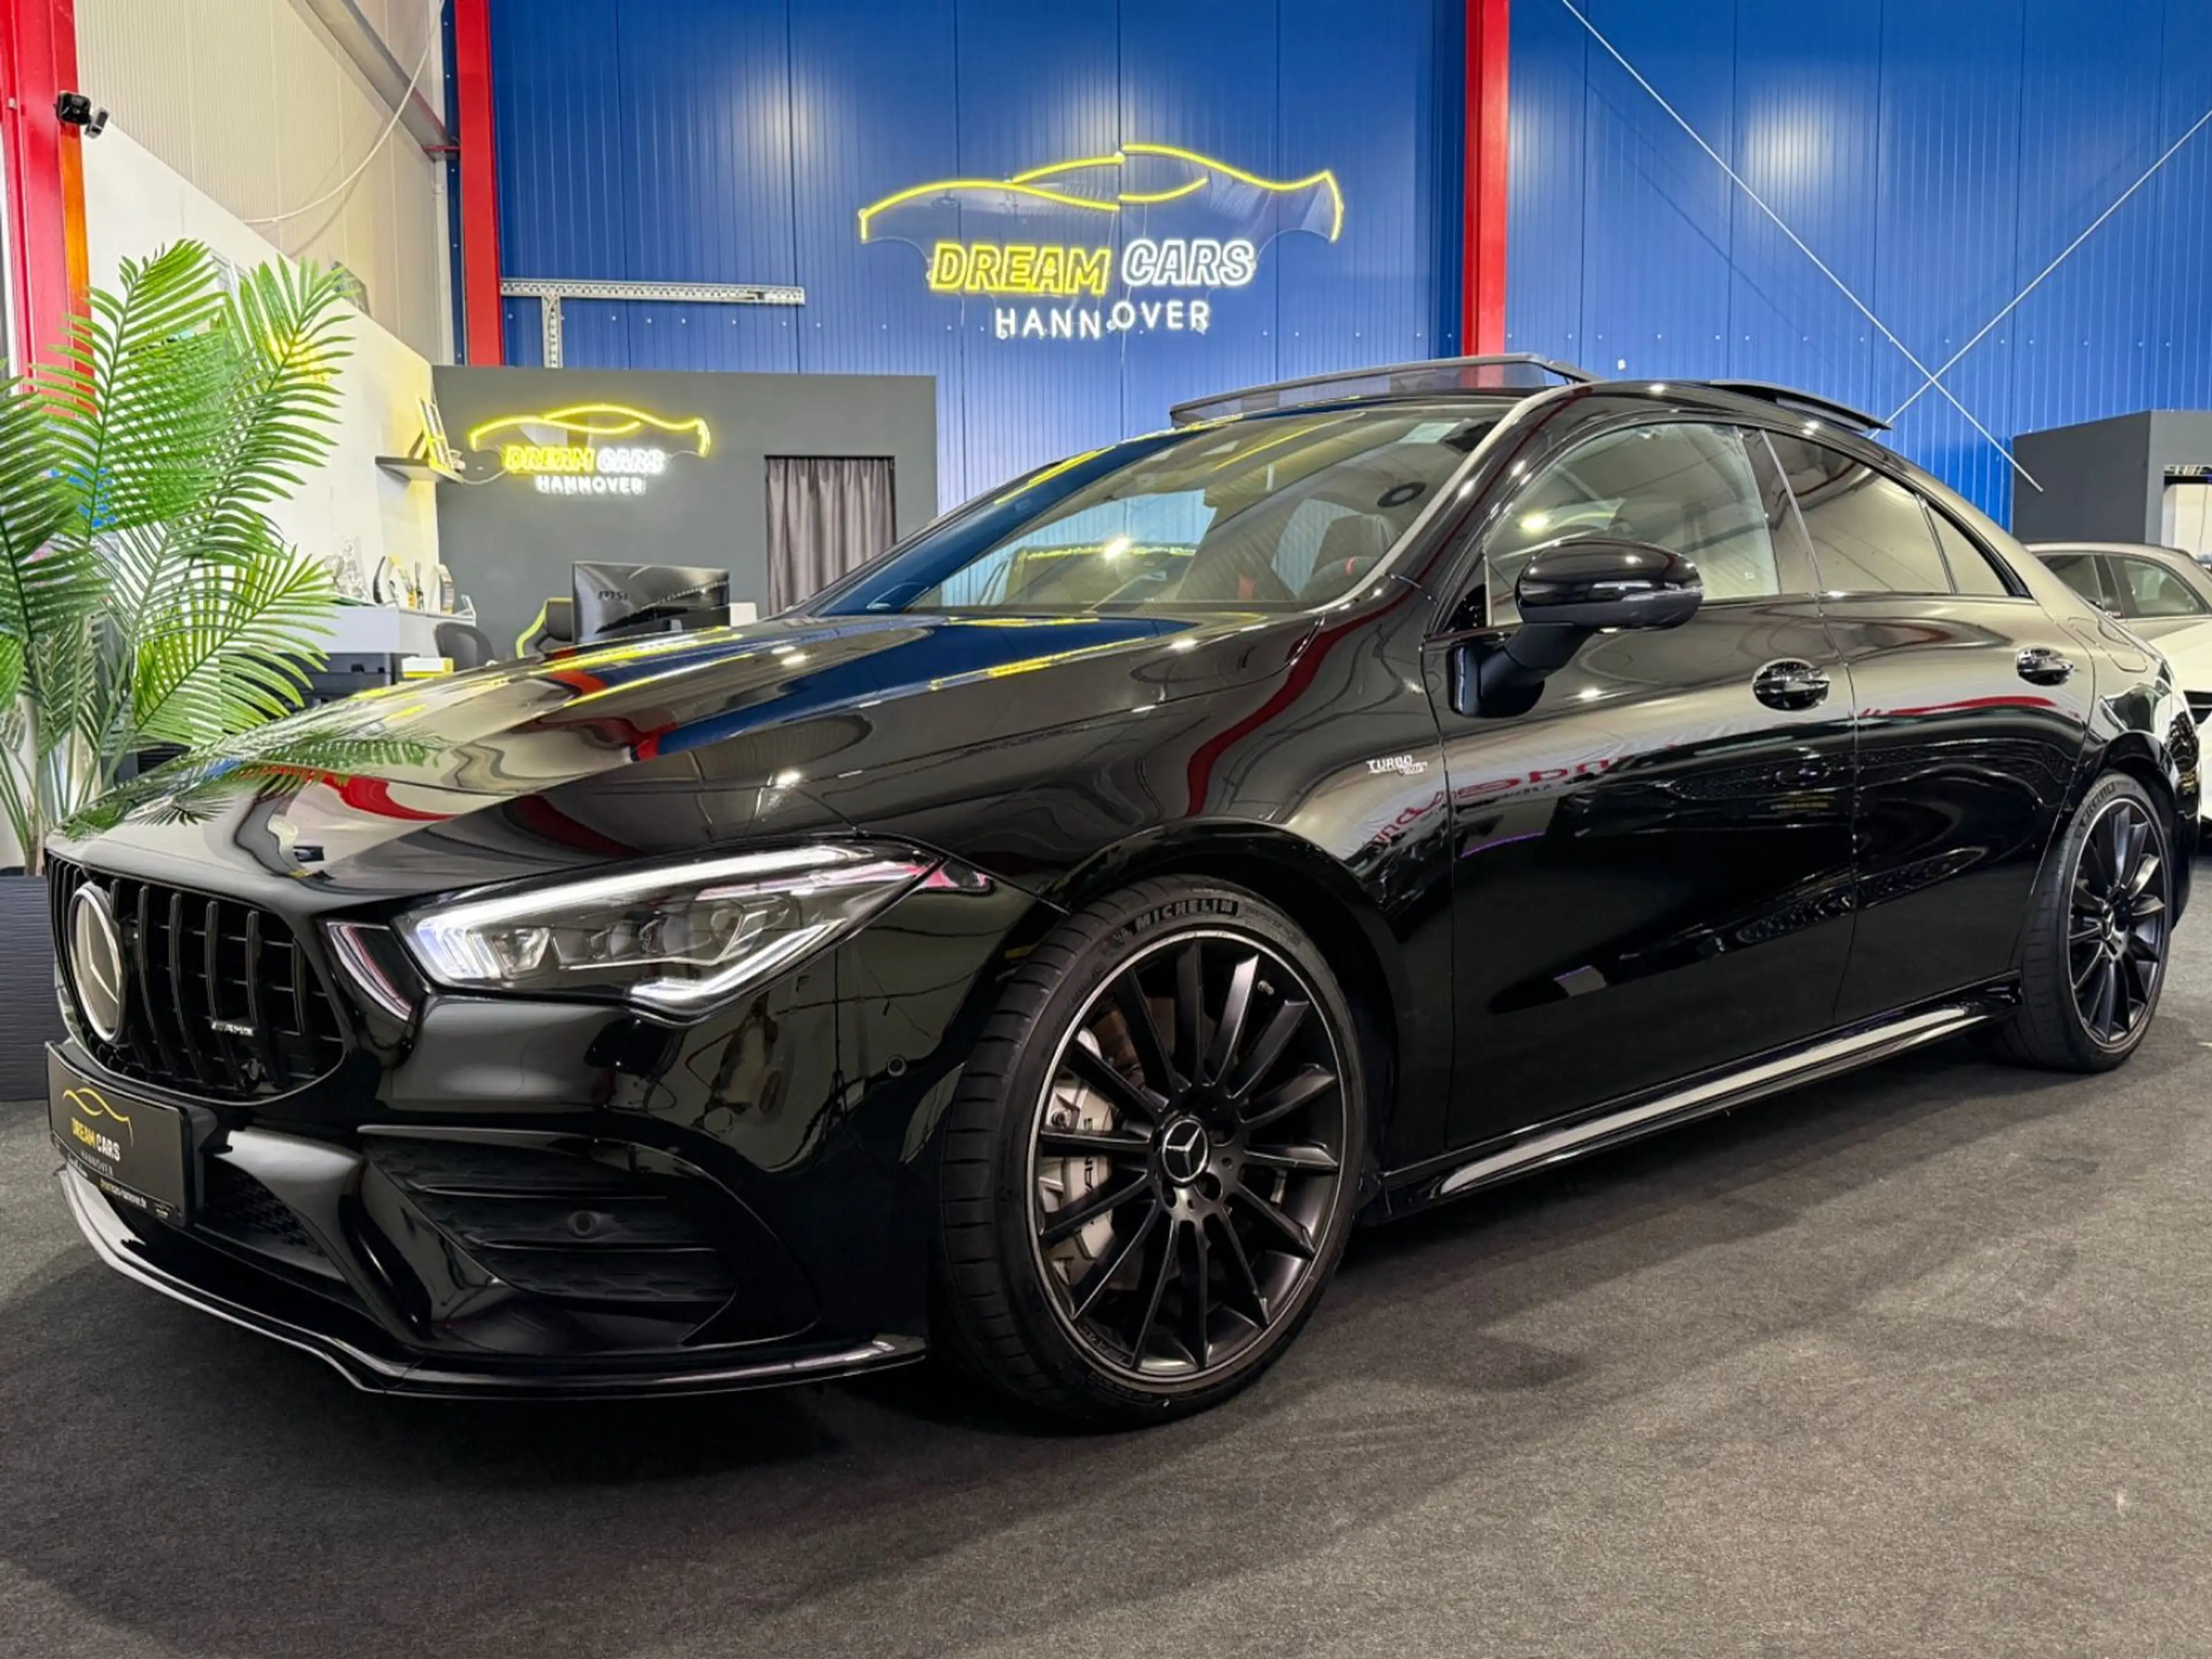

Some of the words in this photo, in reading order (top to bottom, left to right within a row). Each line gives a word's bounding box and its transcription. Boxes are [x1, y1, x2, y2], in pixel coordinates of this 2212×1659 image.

[930, 242, 1112, 297] DREAM
[1122, 238, 1255, 287] CARS
[995, 300, 1211, 340] HANNOVER
[504, 446, 596, 474] DREAM
[535, 475, 646, 495] HANNOVER
[1365, 755, 1412, 774] TURBO
[1134, 899, 1234, 933] MICHELIN
